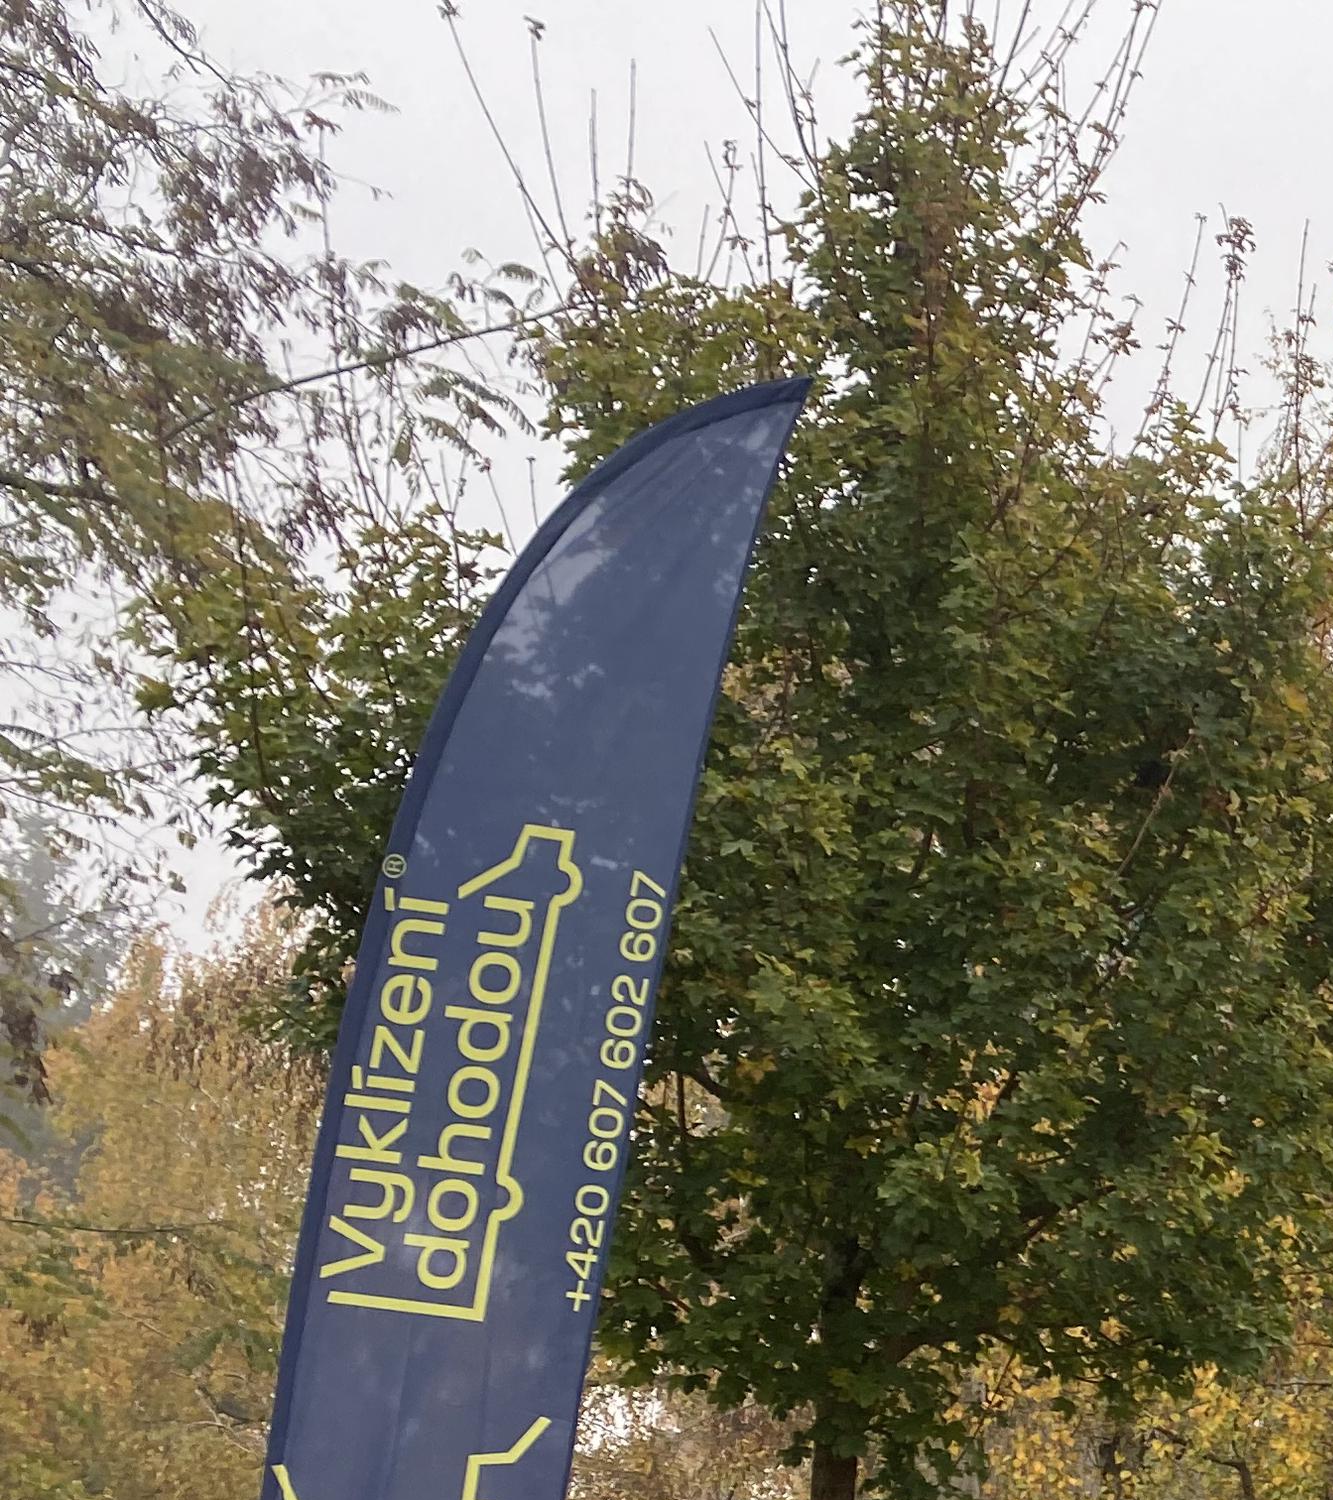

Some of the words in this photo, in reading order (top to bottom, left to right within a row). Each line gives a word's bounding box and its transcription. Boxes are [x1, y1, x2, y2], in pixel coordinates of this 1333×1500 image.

[619, 870, 667, 963] 607
[601, 977, 649, 1070] 602
[319, 886, 449, 1279] Vyklízení
[403, 895, 535, 1289] dohodou
[583, 1079, 628, 1172] 607
[566, 1184, 610, 1312] +420
